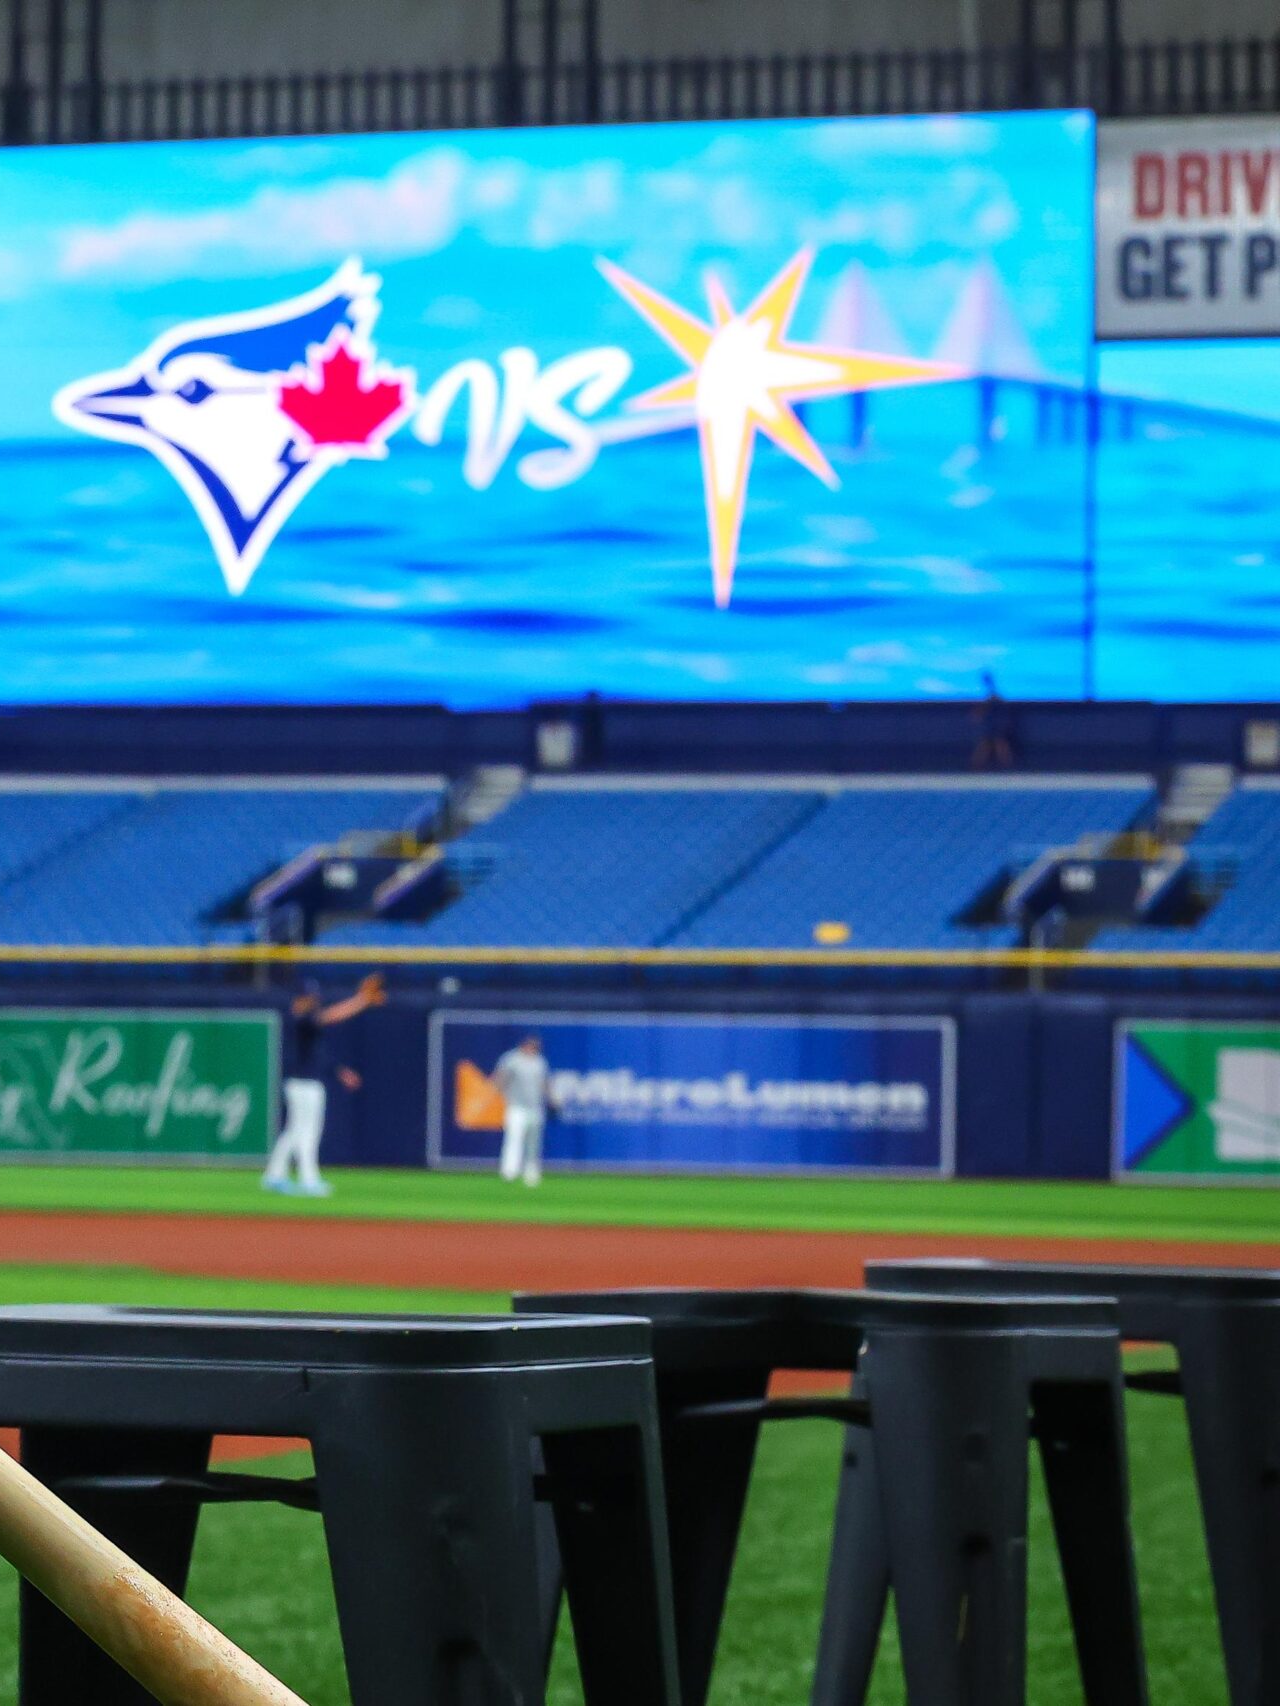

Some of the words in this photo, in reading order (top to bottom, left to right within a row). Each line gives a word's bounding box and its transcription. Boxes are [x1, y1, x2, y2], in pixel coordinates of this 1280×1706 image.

[1134, 152, 1280, 218] DRIV
[1120, 232, 1228, 300] GET
[49, 1026, 251, 1140] Roofing
